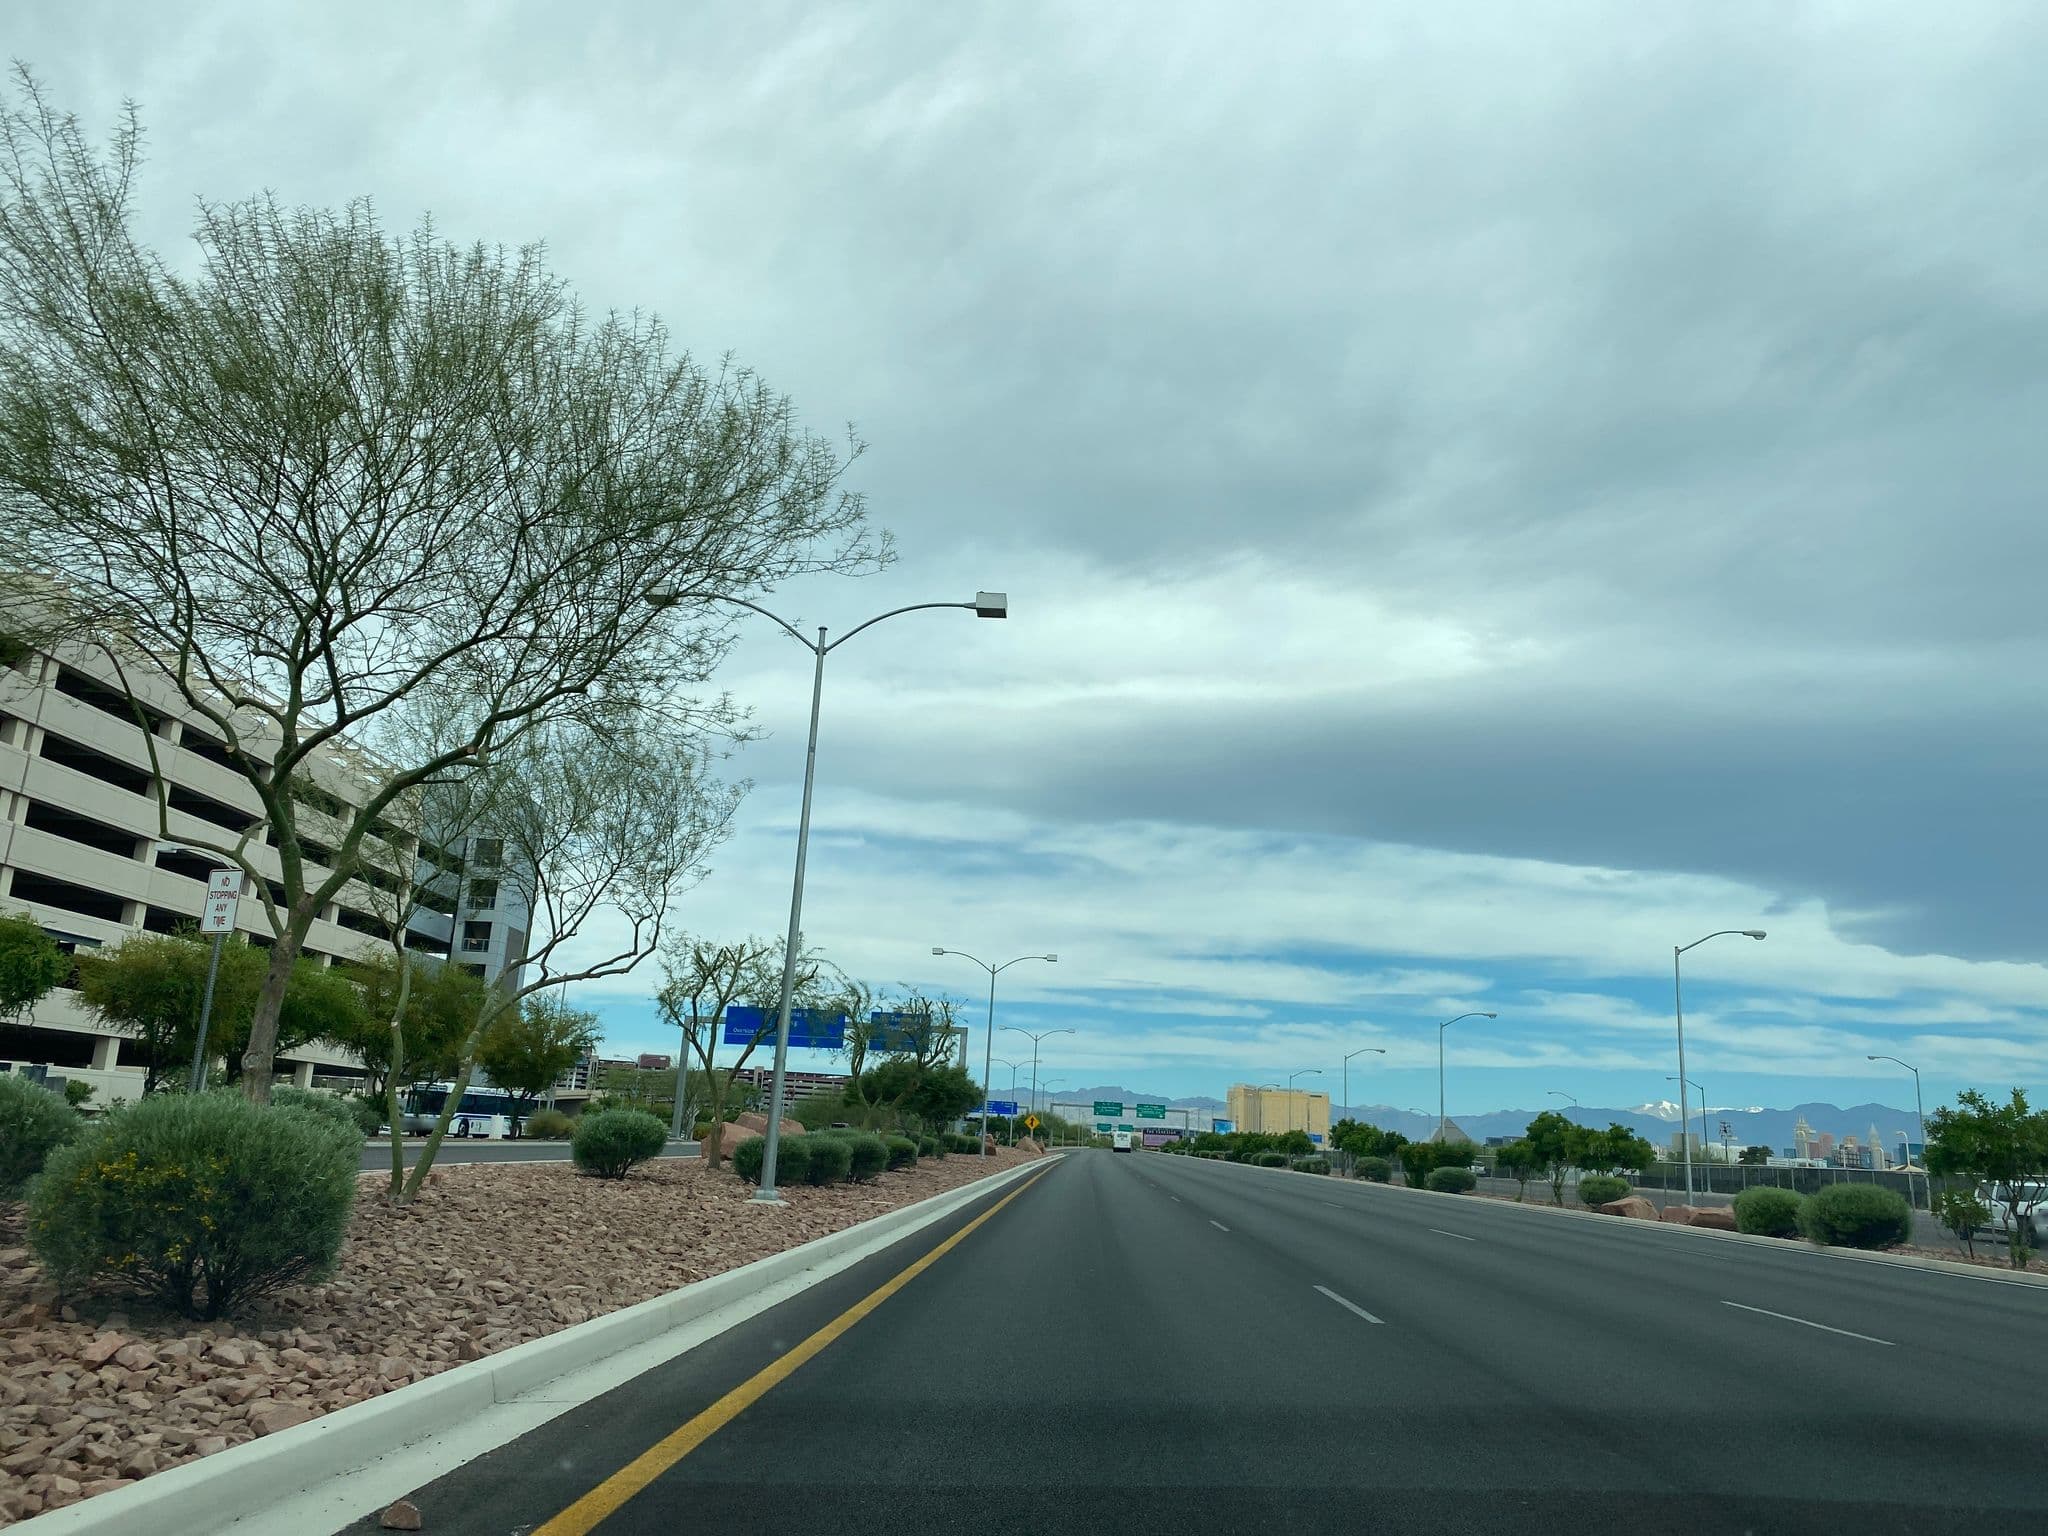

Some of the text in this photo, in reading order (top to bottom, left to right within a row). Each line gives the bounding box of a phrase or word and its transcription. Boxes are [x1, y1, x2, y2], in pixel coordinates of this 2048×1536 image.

[221, 876, 230, 887] NO
[209, 890, 238, 900] STOPPING
[215, 903, 228, 912] ANY
[213, 915, 227, 927] TIME
